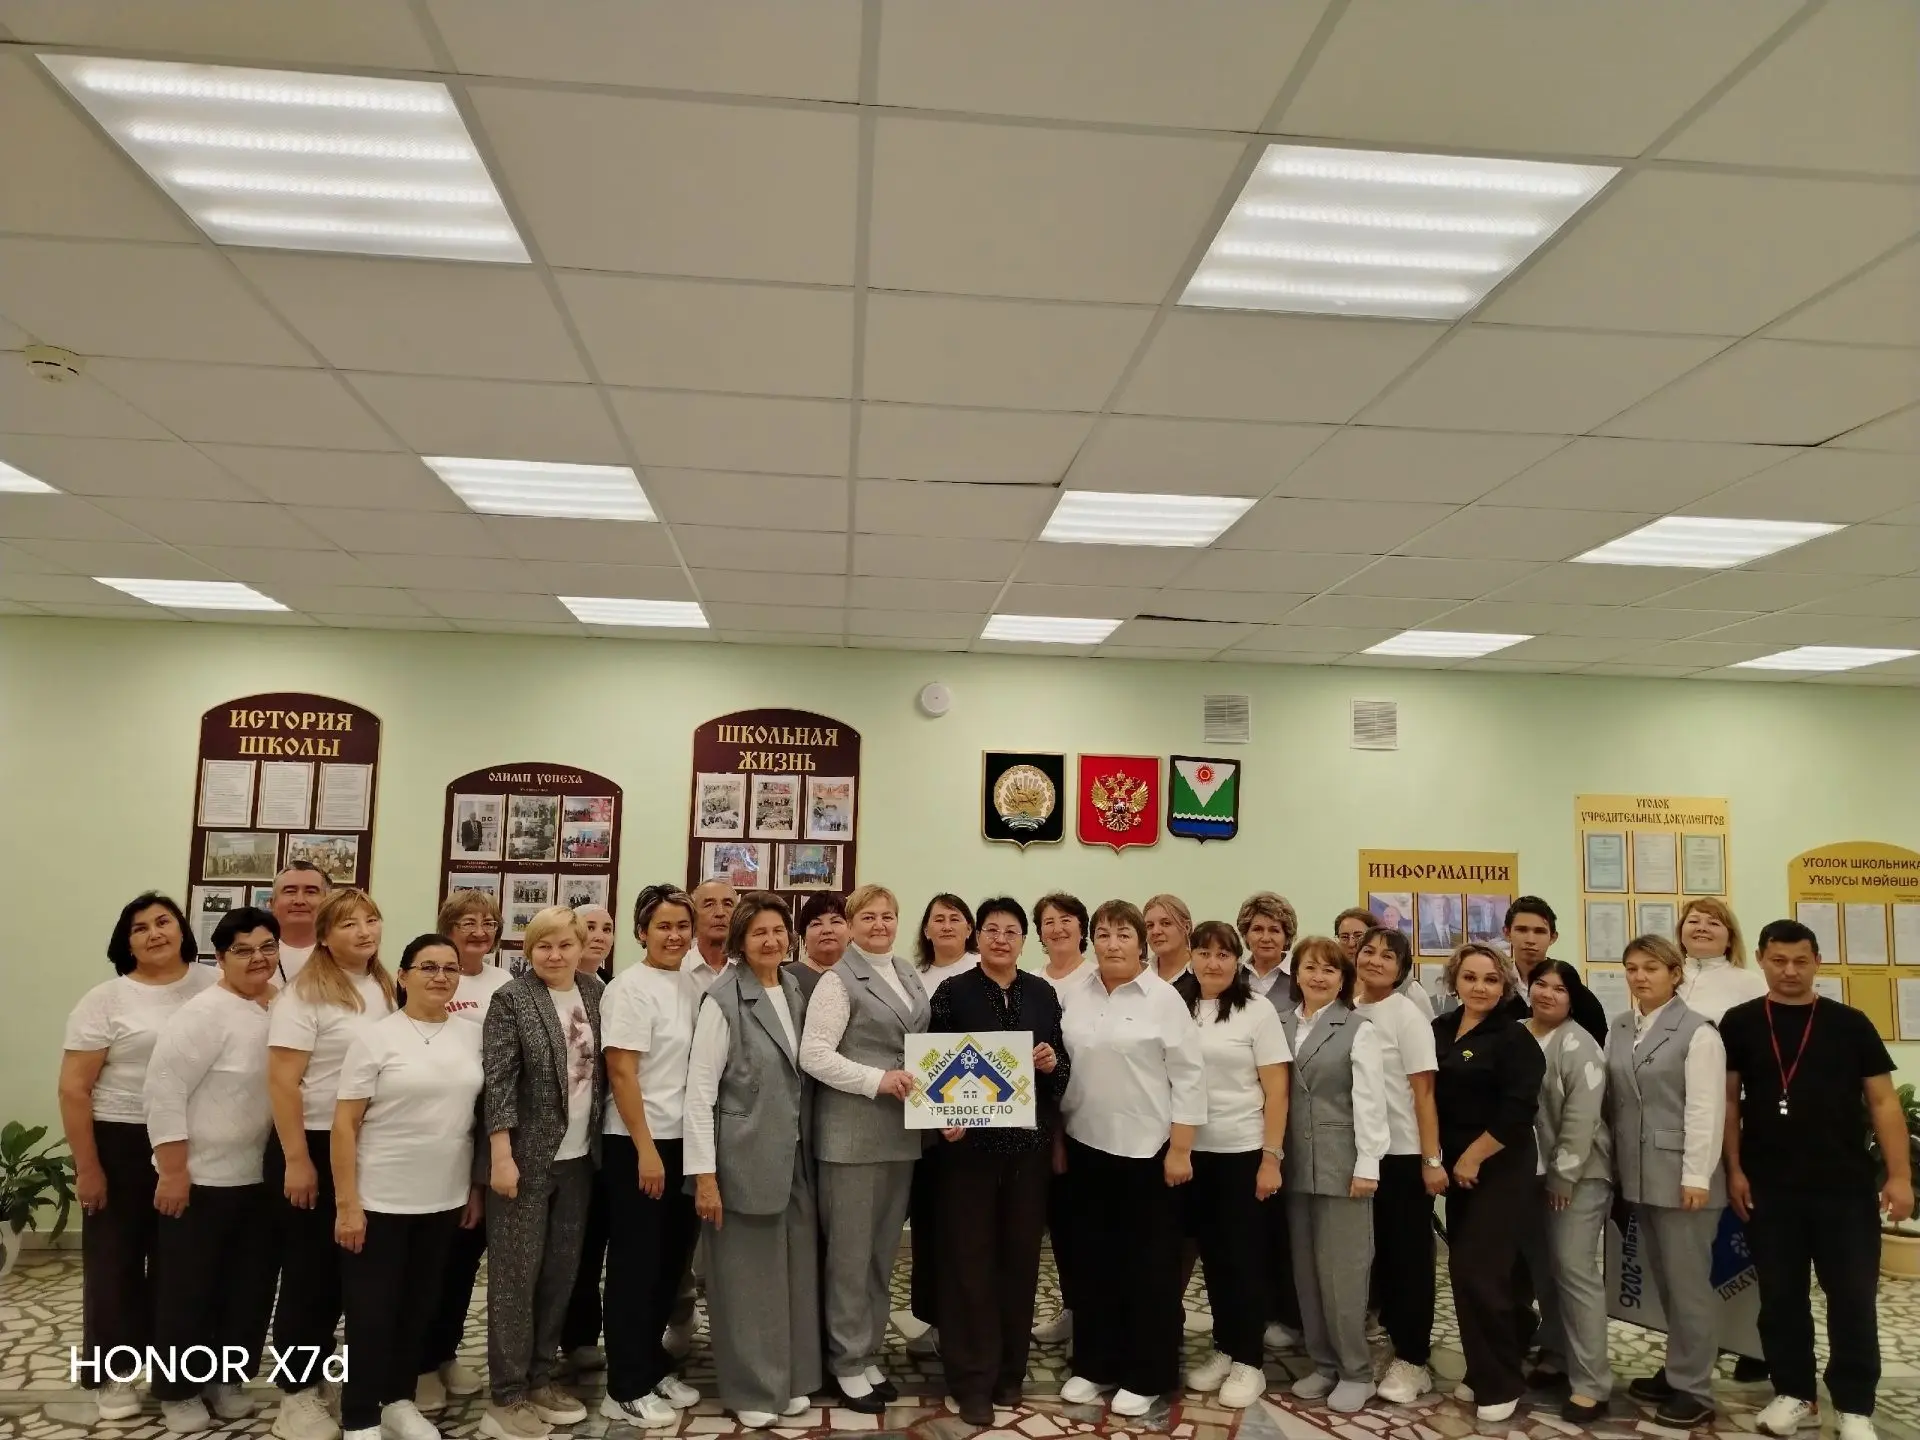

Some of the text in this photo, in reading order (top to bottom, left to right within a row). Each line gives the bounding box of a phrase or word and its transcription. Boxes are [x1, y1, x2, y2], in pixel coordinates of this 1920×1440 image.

[229, 709, 353, 732] ИСТОРИЯ
[716, 724, 839, 747] ШКОЛЬНАЯ
[238, 736, 341, 757] ШКОЛЫ
[737, 751, 816, 772] ЖИЗНЬ
[488, 772, 584, 785] ОЛИМП УСПЕХА
[1636, 798, 1670, 810] УГОЛОК
[1581, 811, 1726, 826] УЧРЕДИТЕЛЬНЫХ ДОКУМЕНТОВ
[1802, 857, 1848, 869] УГОЛОК
[1368, 862, 1511, 884] ИНФОРМАЦИЯ
[984, 1050, 1013, 1079] АУЫЛ
[929, 1105, 1013, 1116] ТРЕЗВОЕ СЕЛО
[946, 1117, 991, 1127] КАРАЯР
